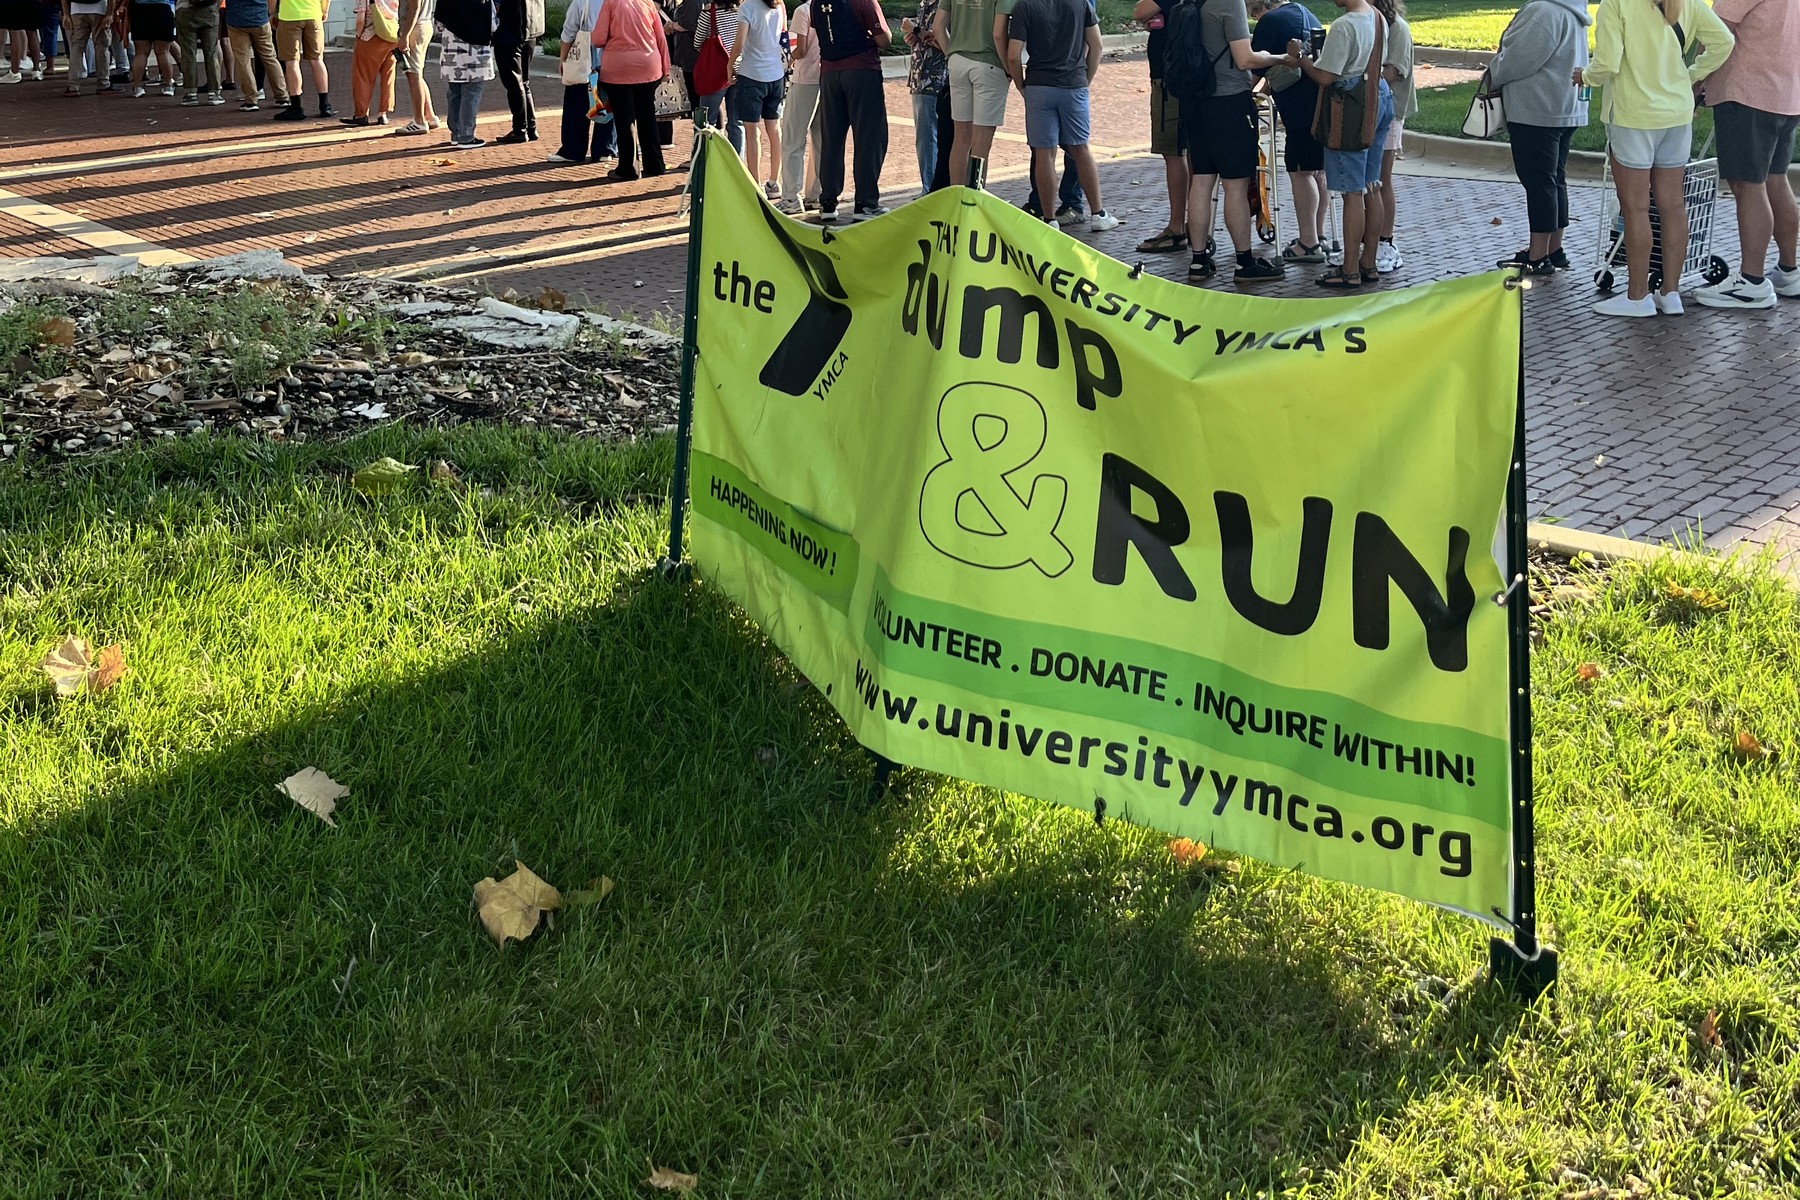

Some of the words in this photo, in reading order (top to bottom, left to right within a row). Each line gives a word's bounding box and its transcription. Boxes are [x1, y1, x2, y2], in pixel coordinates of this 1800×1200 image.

[713, 260, 776, 314] the
[902, 238, 1123, 411] dump
[969, 229, 1202, 346] UNIVERSITY
[812, 351, 849, 401] YMCA
[710, 475, 787, 545] HAPPENING
[790, 527, 837, 577] NOW!
[919, 381, 1075, 579] &
[1092, 452, 1476, 673] RUN
[873, 590, 1002, 669] VOLUNTEER
[1029, 647, 1168, 702] DONATE
[1193, 682, 1328, 750] INQUIRE
[1333, 723, 1477, 788] WITHIN!
[855, 658, 1472, 878] www.universityymca.org
